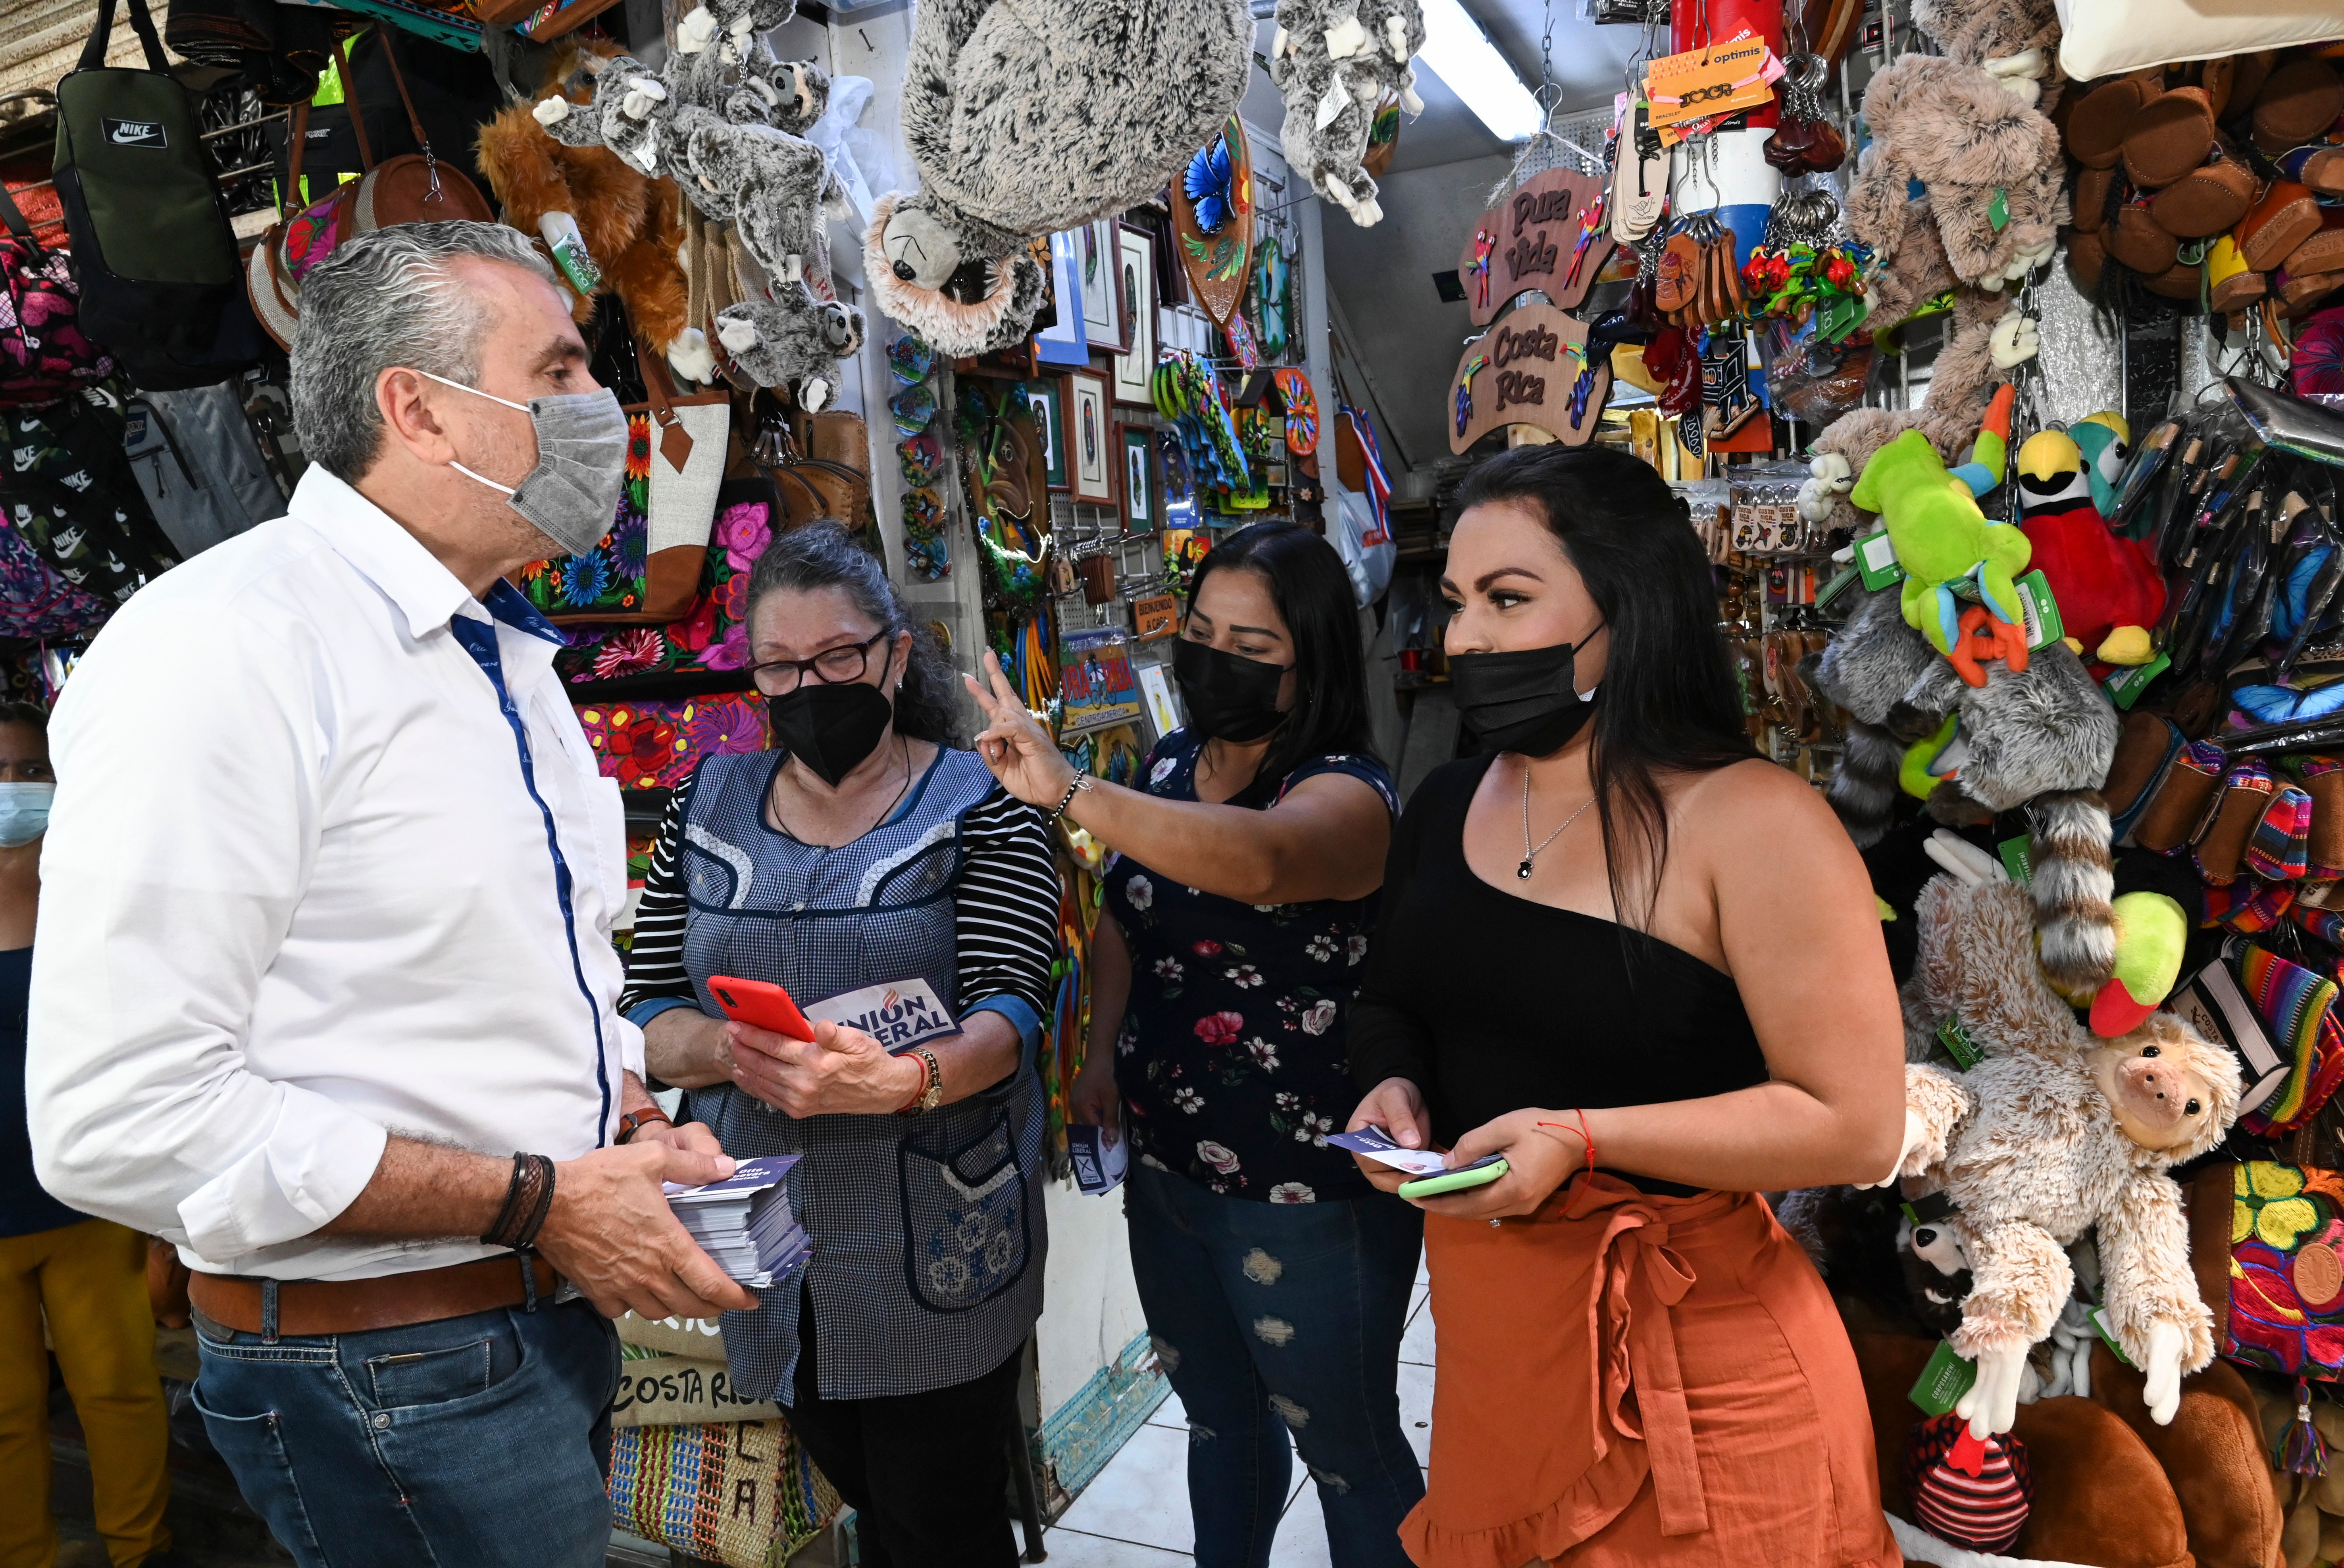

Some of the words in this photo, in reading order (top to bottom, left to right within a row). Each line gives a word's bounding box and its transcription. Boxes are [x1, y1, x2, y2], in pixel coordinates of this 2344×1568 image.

[1714, 47, 1760, 64] optimis
[1655, 111, 1681, 120] BRACELET
[119, 123, 150, 136] NIKE
[1513, 189, 1571, 237] Pura
[1505, 230, 1558, 281] Vida
[2302, 240, 2340, 256] COSTA
[567, 259, 589, 286] fauna
[1493, 323, 1558, 367] Costa
[1495, 370, 1545, 411] Rica
[15, 504, 30, 518] NIK
[52, 526, 78, 548] NIKE
[113, 582, 136, 600] NIKE
[1139, 598, 1172, 616] BIENVENIDO
[1068, 640, 1089, 652] COSTA
[1061, 665, 1092, 701] URA
[1101, 657, 1134, 693] VIDA
[1076, 707, 1126, 726] CENTROAMERICA
[867, 1011, 949, 1047] ERAL
[2202, 1014, 2219, 1041] COSTA
[1954, 1033, 1962, 1042] de
[1962, 1042, 1976, 1061] Costa
[2322, 1252, 2337, 1279] COSTA
[611, 1368, 703, 1413] COSTA
[711, 1372, 764, 1409] RI
